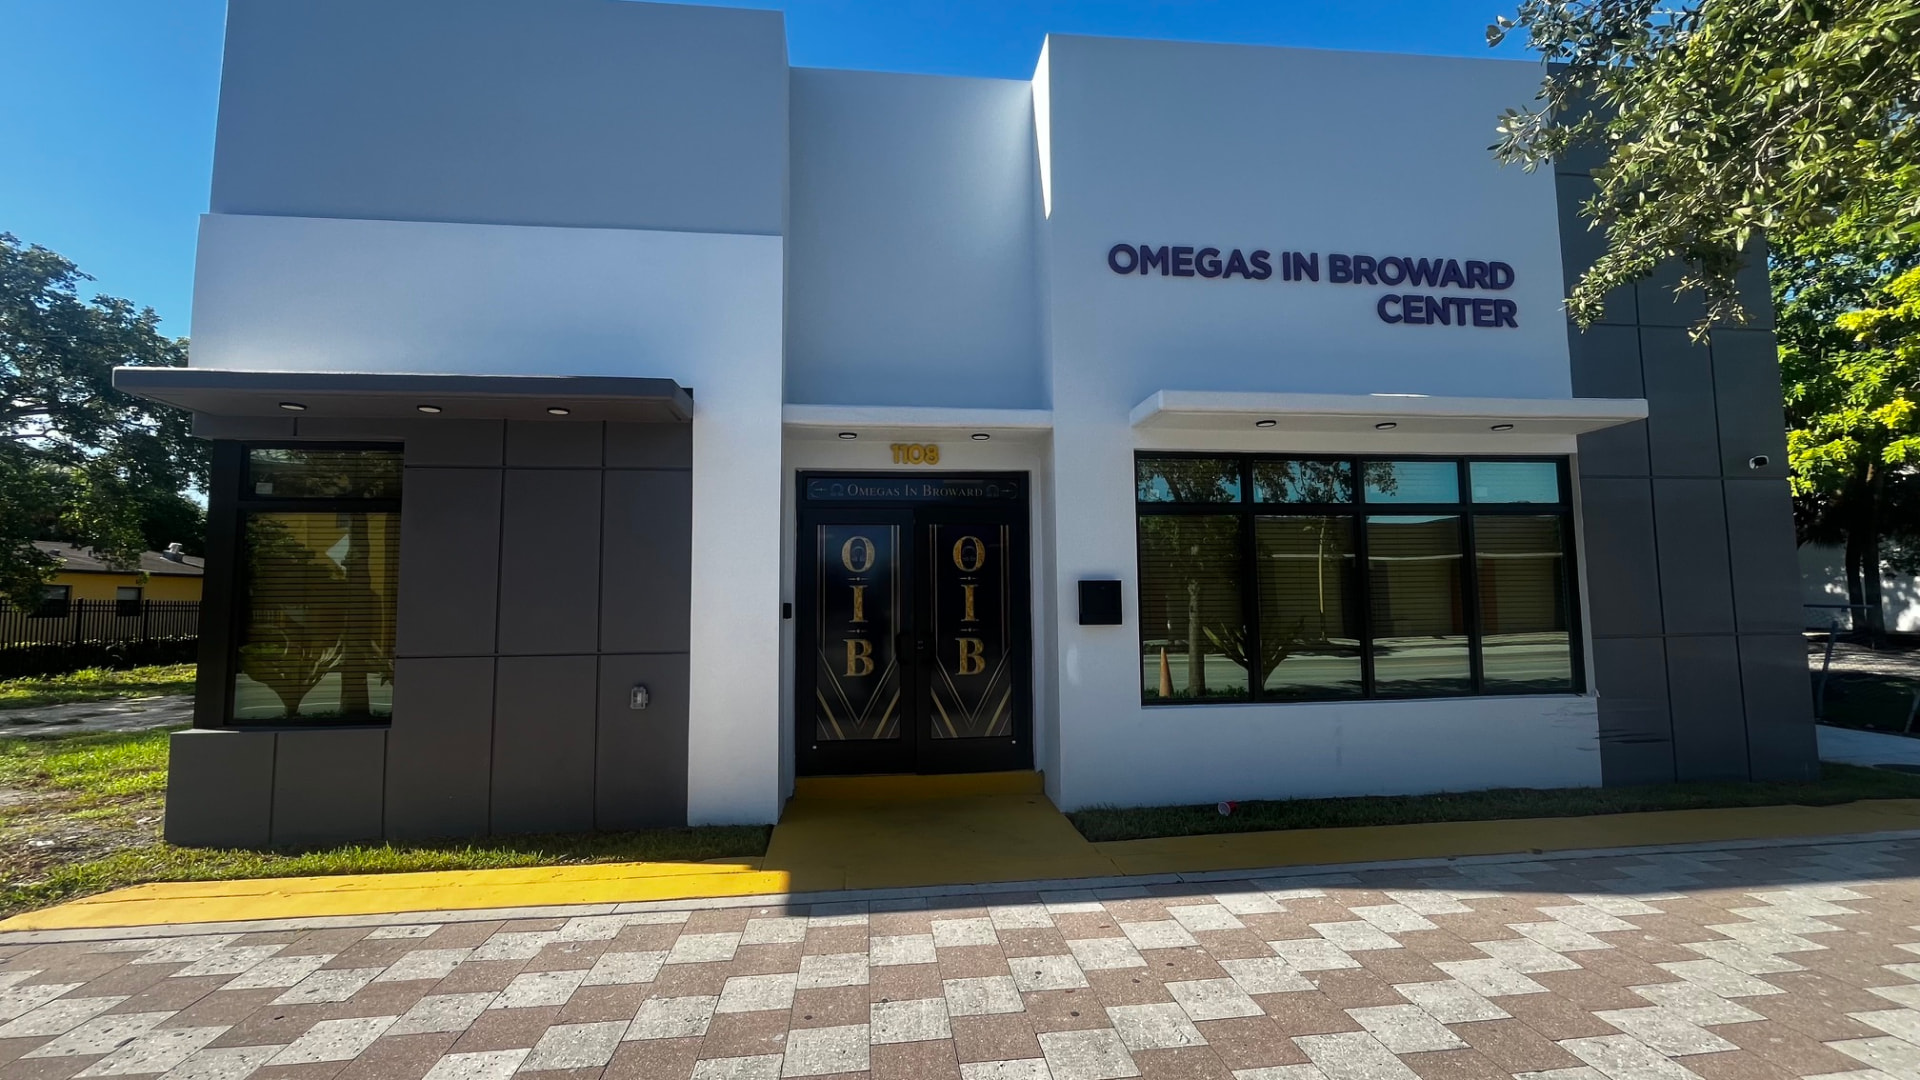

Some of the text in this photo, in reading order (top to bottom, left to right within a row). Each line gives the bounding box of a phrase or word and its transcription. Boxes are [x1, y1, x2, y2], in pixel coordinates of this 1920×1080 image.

[1108, 243, 1515, 290] OMEGAS IN BROWARD
[1377, 294, 1518, 328] CENTER
[890, 443, 940, 465] 1108
